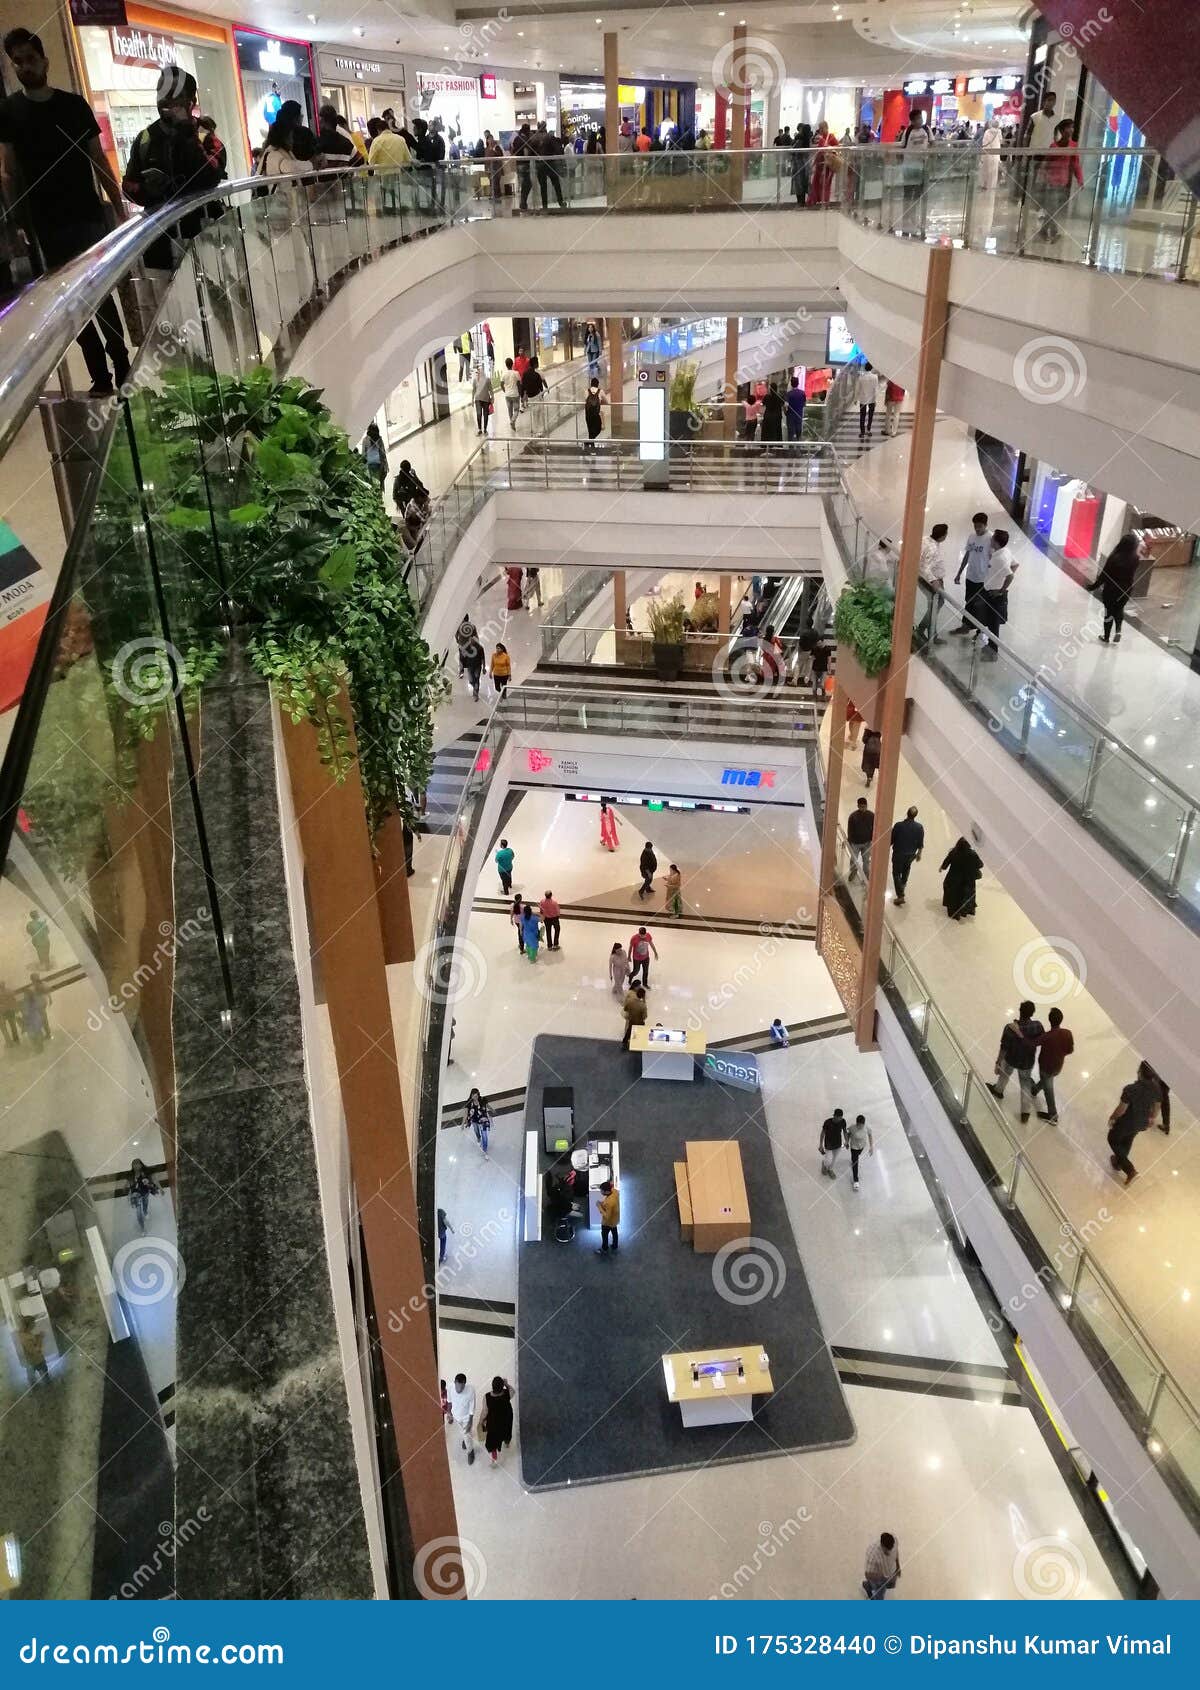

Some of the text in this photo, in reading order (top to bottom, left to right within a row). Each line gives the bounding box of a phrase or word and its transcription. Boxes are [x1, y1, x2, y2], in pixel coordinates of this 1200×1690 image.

[112, 26, 148, 59] health
[148, 33, 158, 61] &
[446, 81, 475, 91] FASHION
